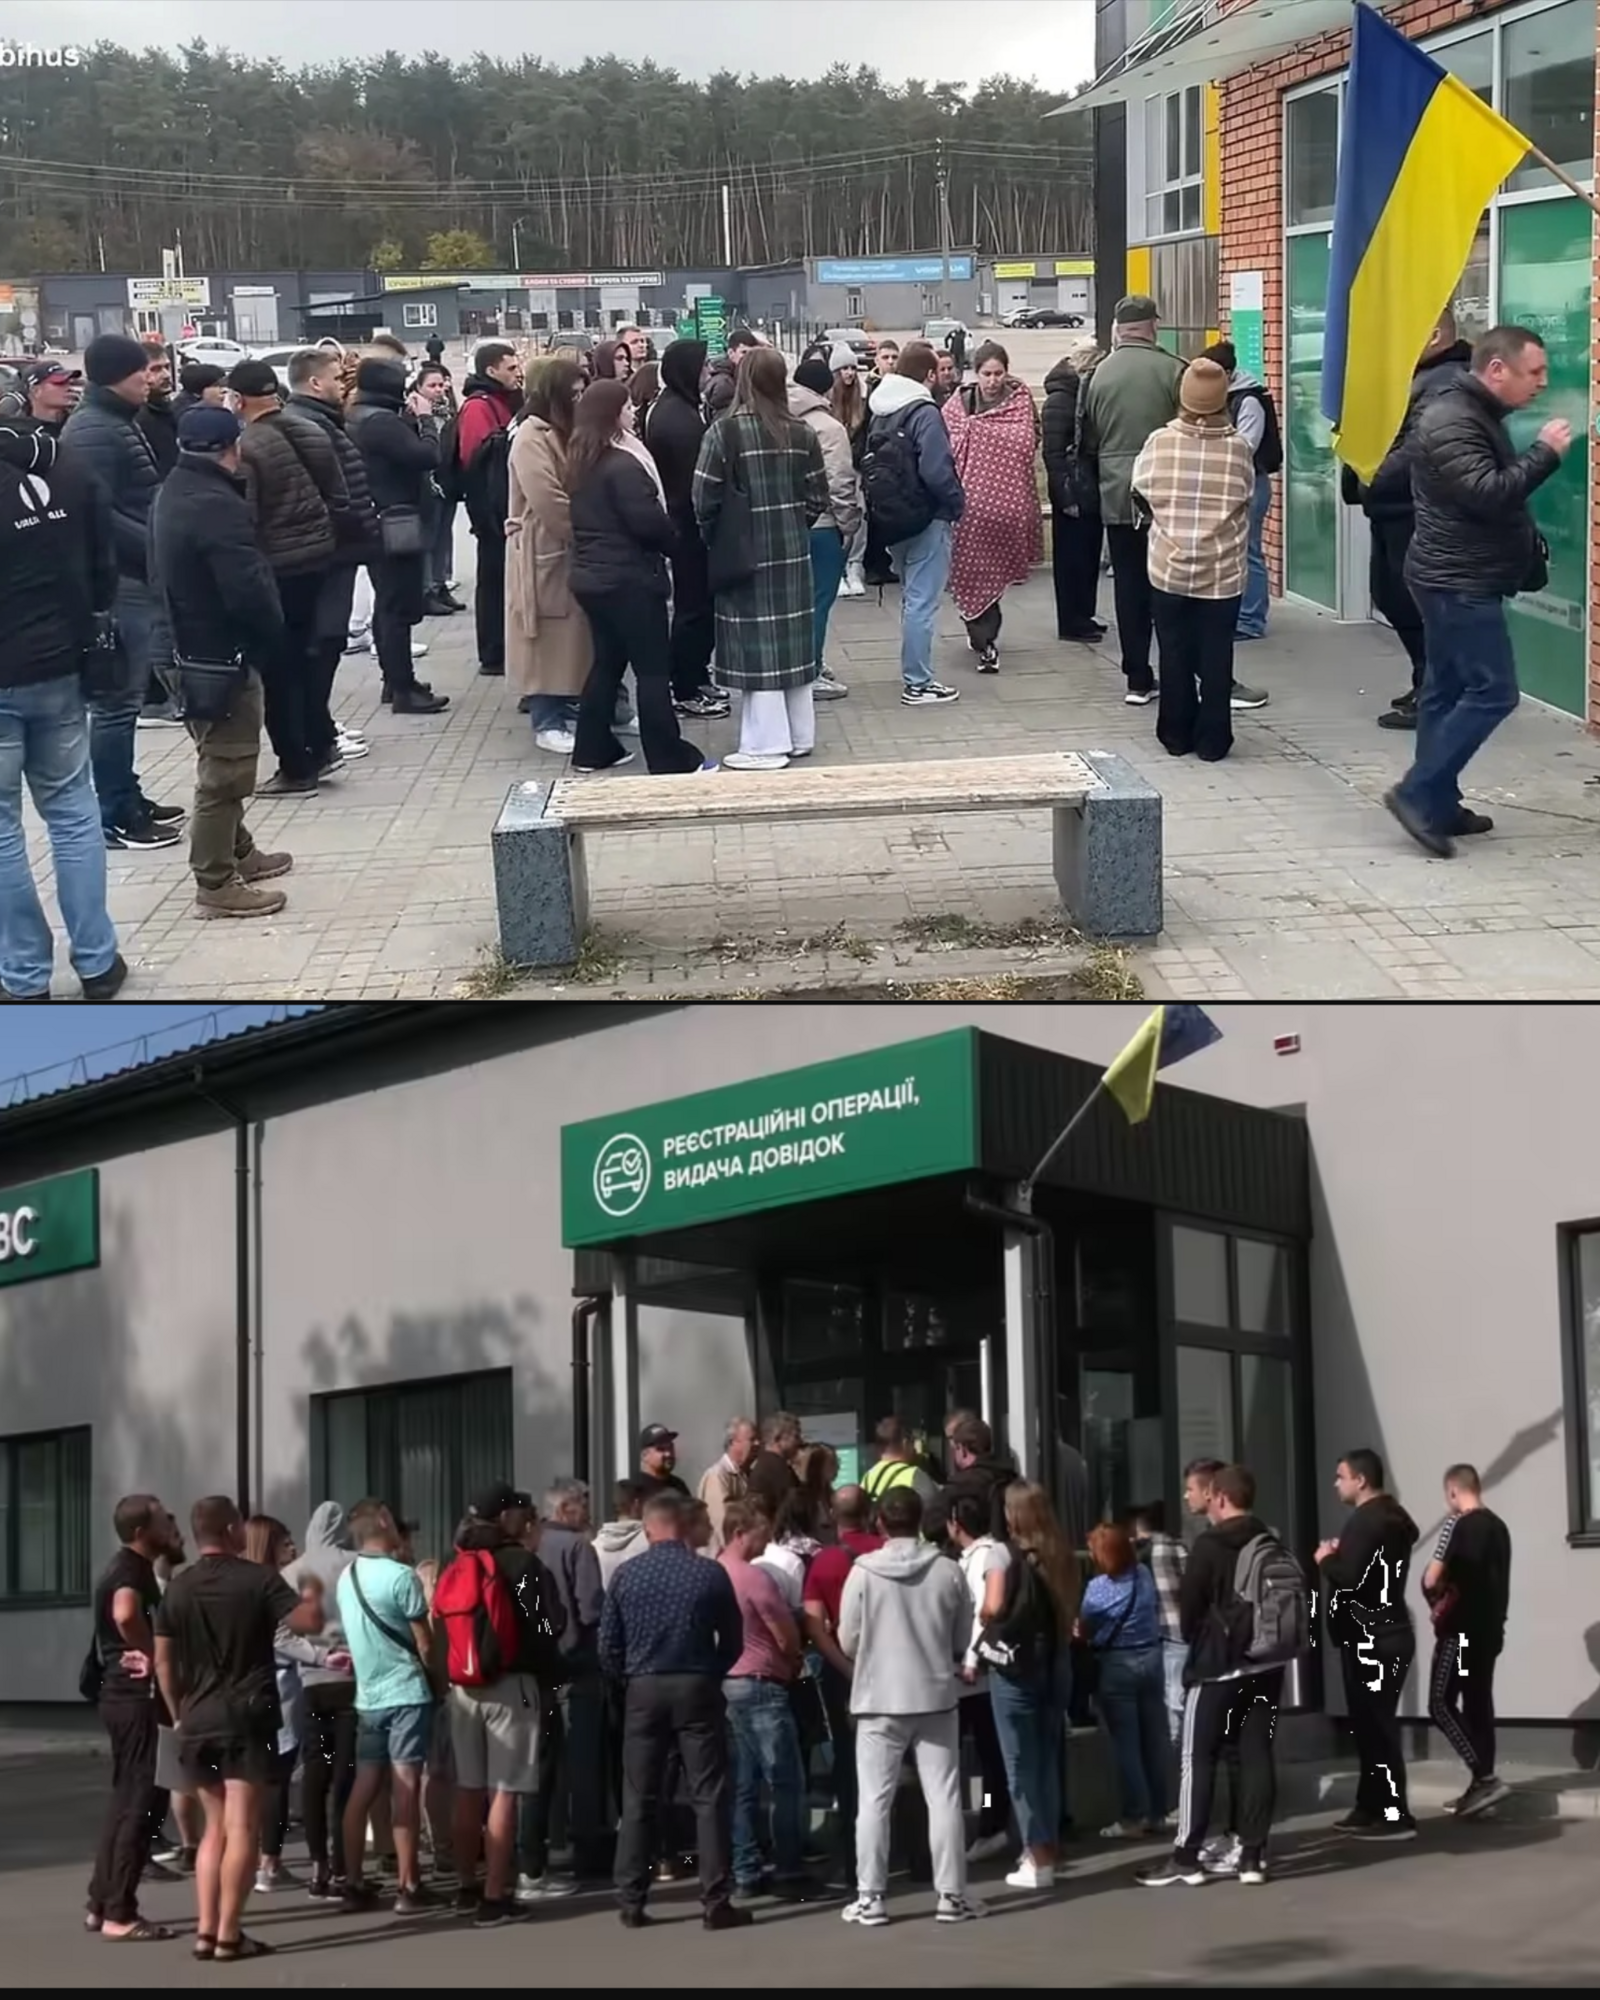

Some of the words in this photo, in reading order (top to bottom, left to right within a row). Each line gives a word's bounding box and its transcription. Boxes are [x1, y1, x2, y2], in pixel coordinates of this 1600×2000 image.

[663, 1107, 806, 1158] РЕЄСТРАЦІЙНІ
[811, 1077, 920, 1126] ОПЕРАЦІЇ,
[664, 1161, 743, 1191] ВИДАЧА
[748, 1132, 846, 1175] ДОВІДОК
